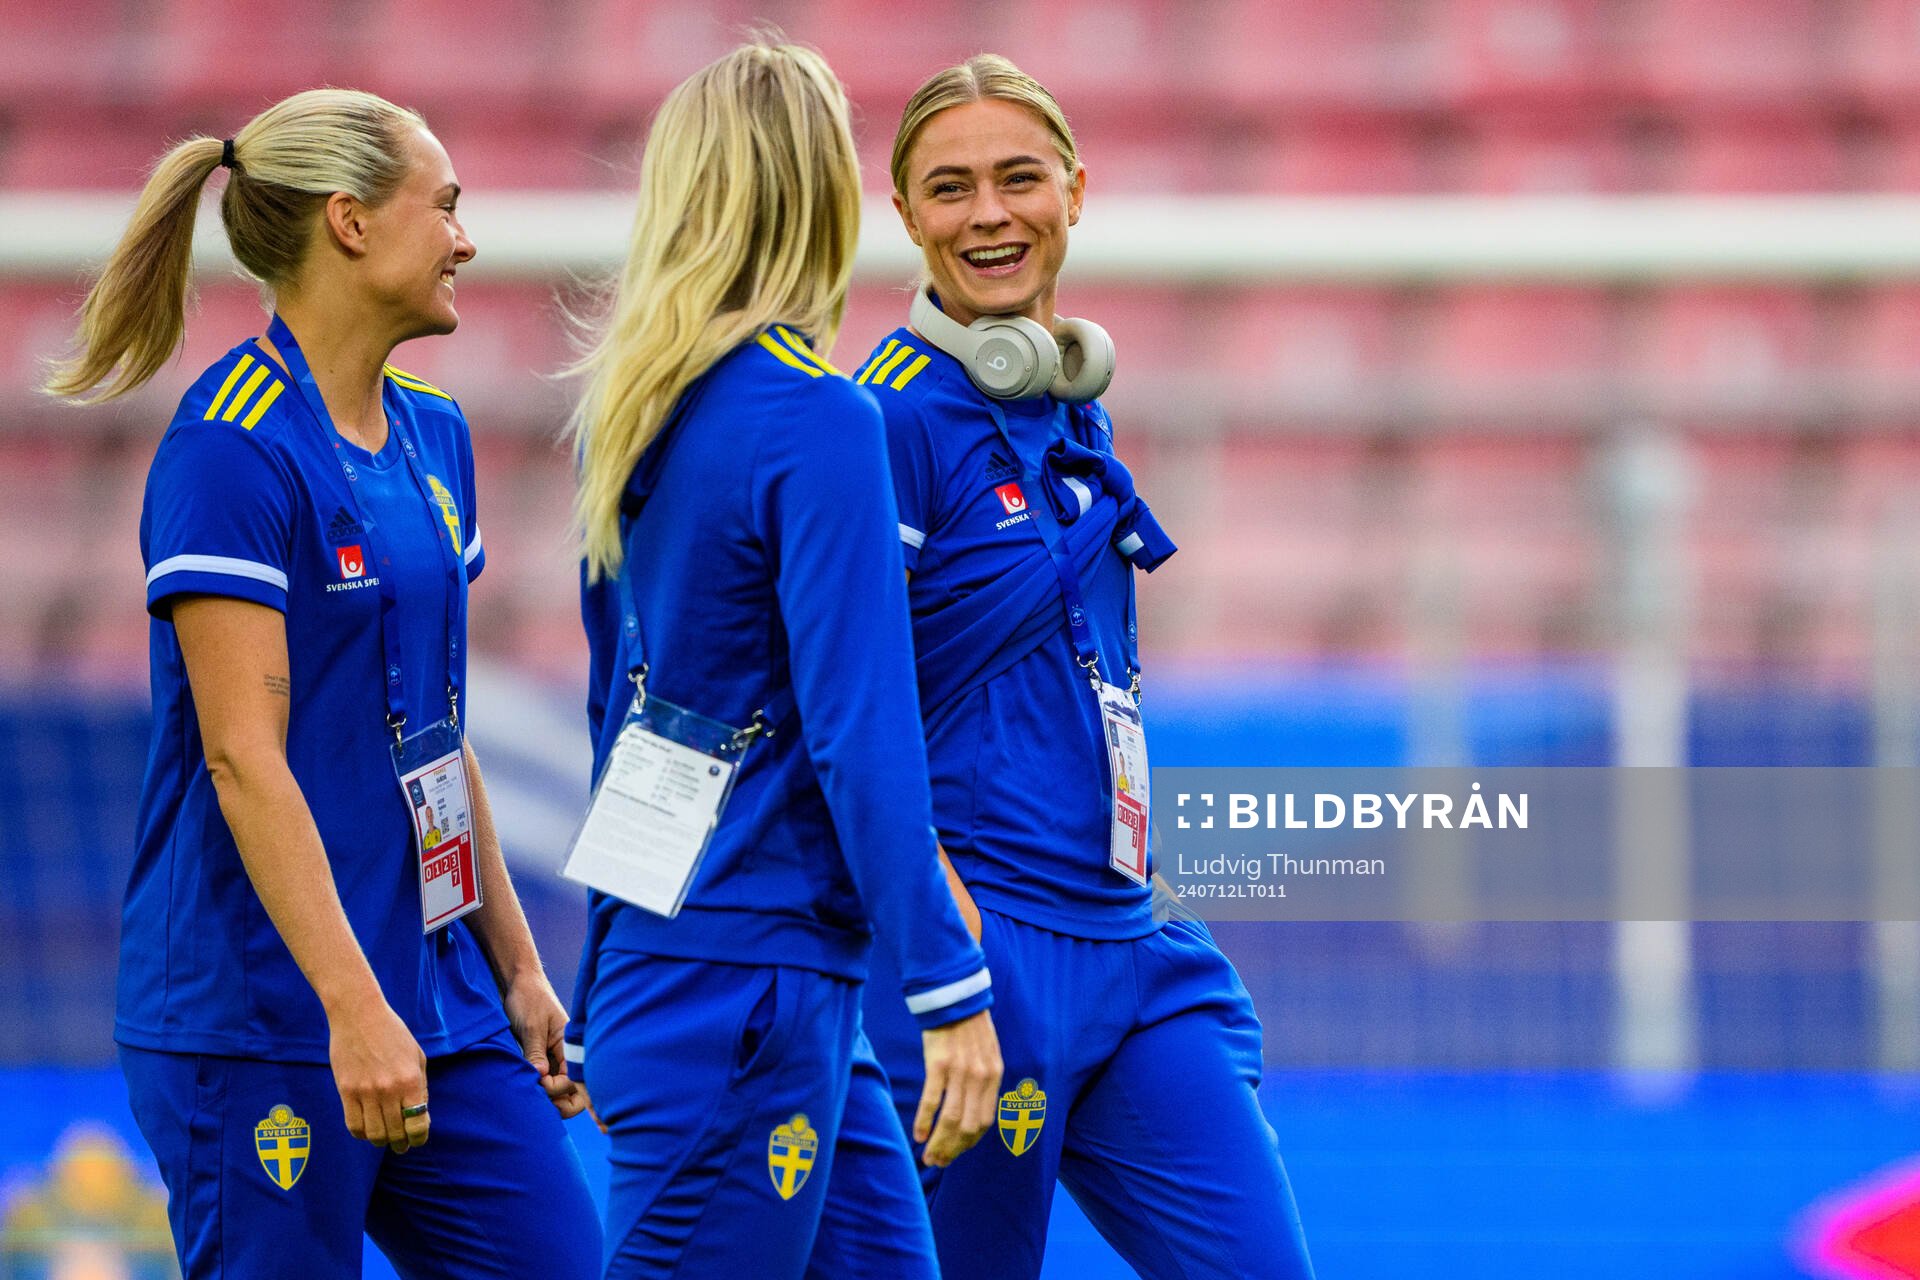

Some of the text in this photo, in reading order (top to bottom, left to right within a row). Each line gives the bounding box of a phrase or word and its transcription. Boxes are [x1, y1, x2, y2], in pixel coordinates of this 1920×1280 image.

[996, 513, 1030, 531] SVENSKA
[326, 580, 363, 592] SVENSKA
[1006, 1101, 1042, 1109] SVERIGE
[262, 1128, 302, 1137] SVERIGE
